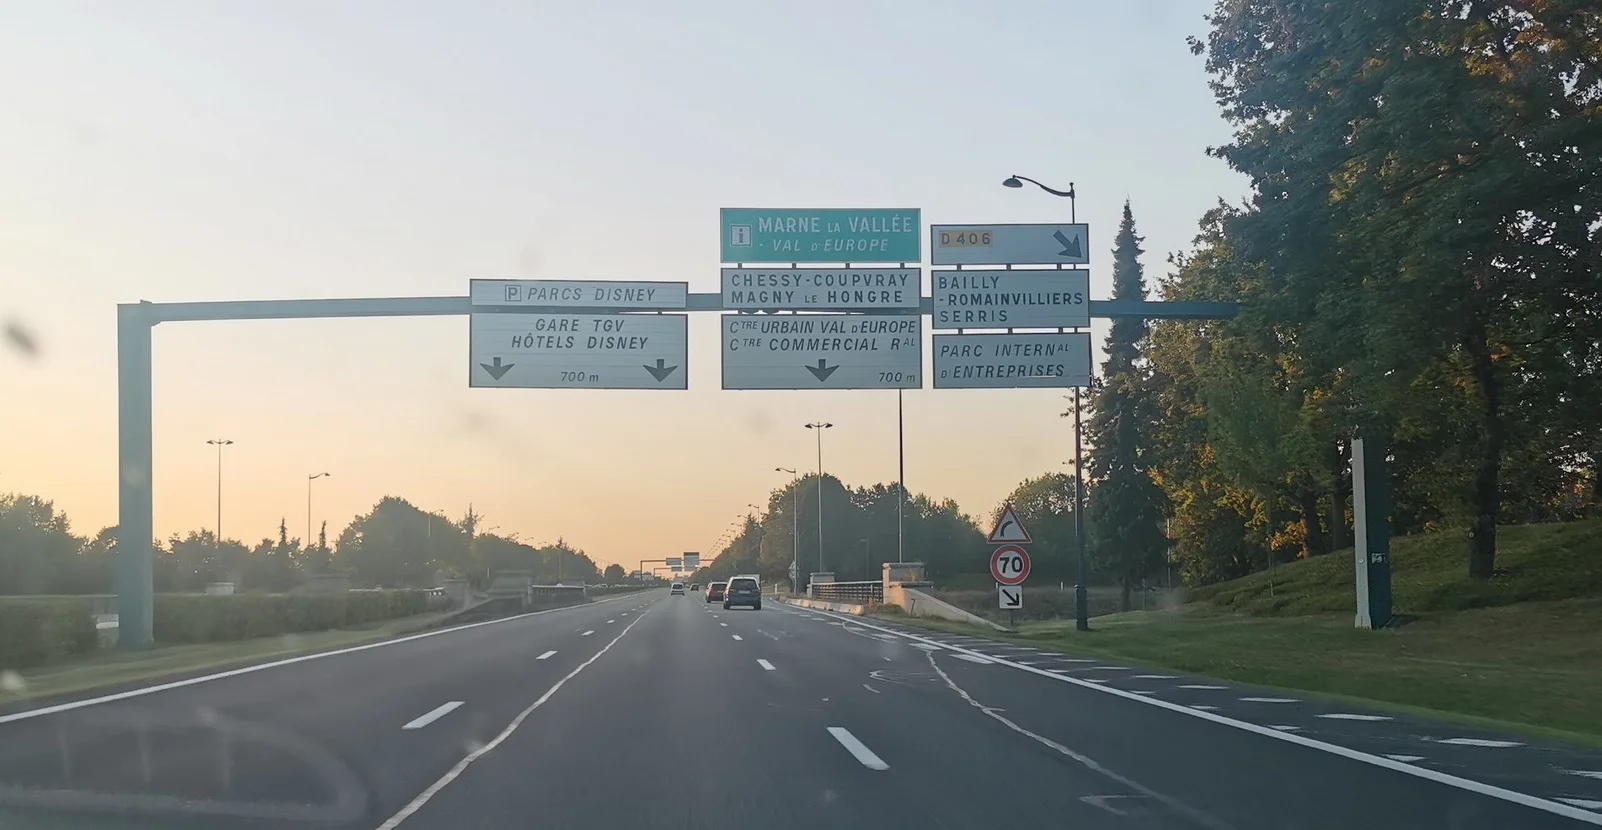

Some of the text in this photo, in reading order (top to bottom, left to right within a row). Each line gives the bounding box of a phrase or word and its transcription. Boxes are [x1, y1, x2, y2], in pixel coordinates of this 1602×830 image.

[758, 214, 912, 232] MARNE LA VALLÉE
[773, 239, 801, 251] VAL
[941, 233, 991, 245] D 406
[731, 274, 908, 287] CHESSY-COUPVRAY
[939, 276, 1000, 289] BAILLY
[508, 287, 656, 302] P PARCS DISNEY
[731, 291, 903, 303] MAGNY LE HONGRE
[939, 310, 1008, 322] SERRIS
[536, 319, 625, 332] GARE TGV
[761, 321, 814, 333] URBAIN
[821, 321, 846, 333] VAL
[511, 333, 648, 349] HÔTELS DISNEY
[769, 339, 878, 351] COMMERCIAL
[940, 343, 1070, 357] PARC INTERNAL
[560, 371, 599, 382] 700 m
[879, 372, 916, 382] 700 m
[999, 556, 1023, 573] 70
